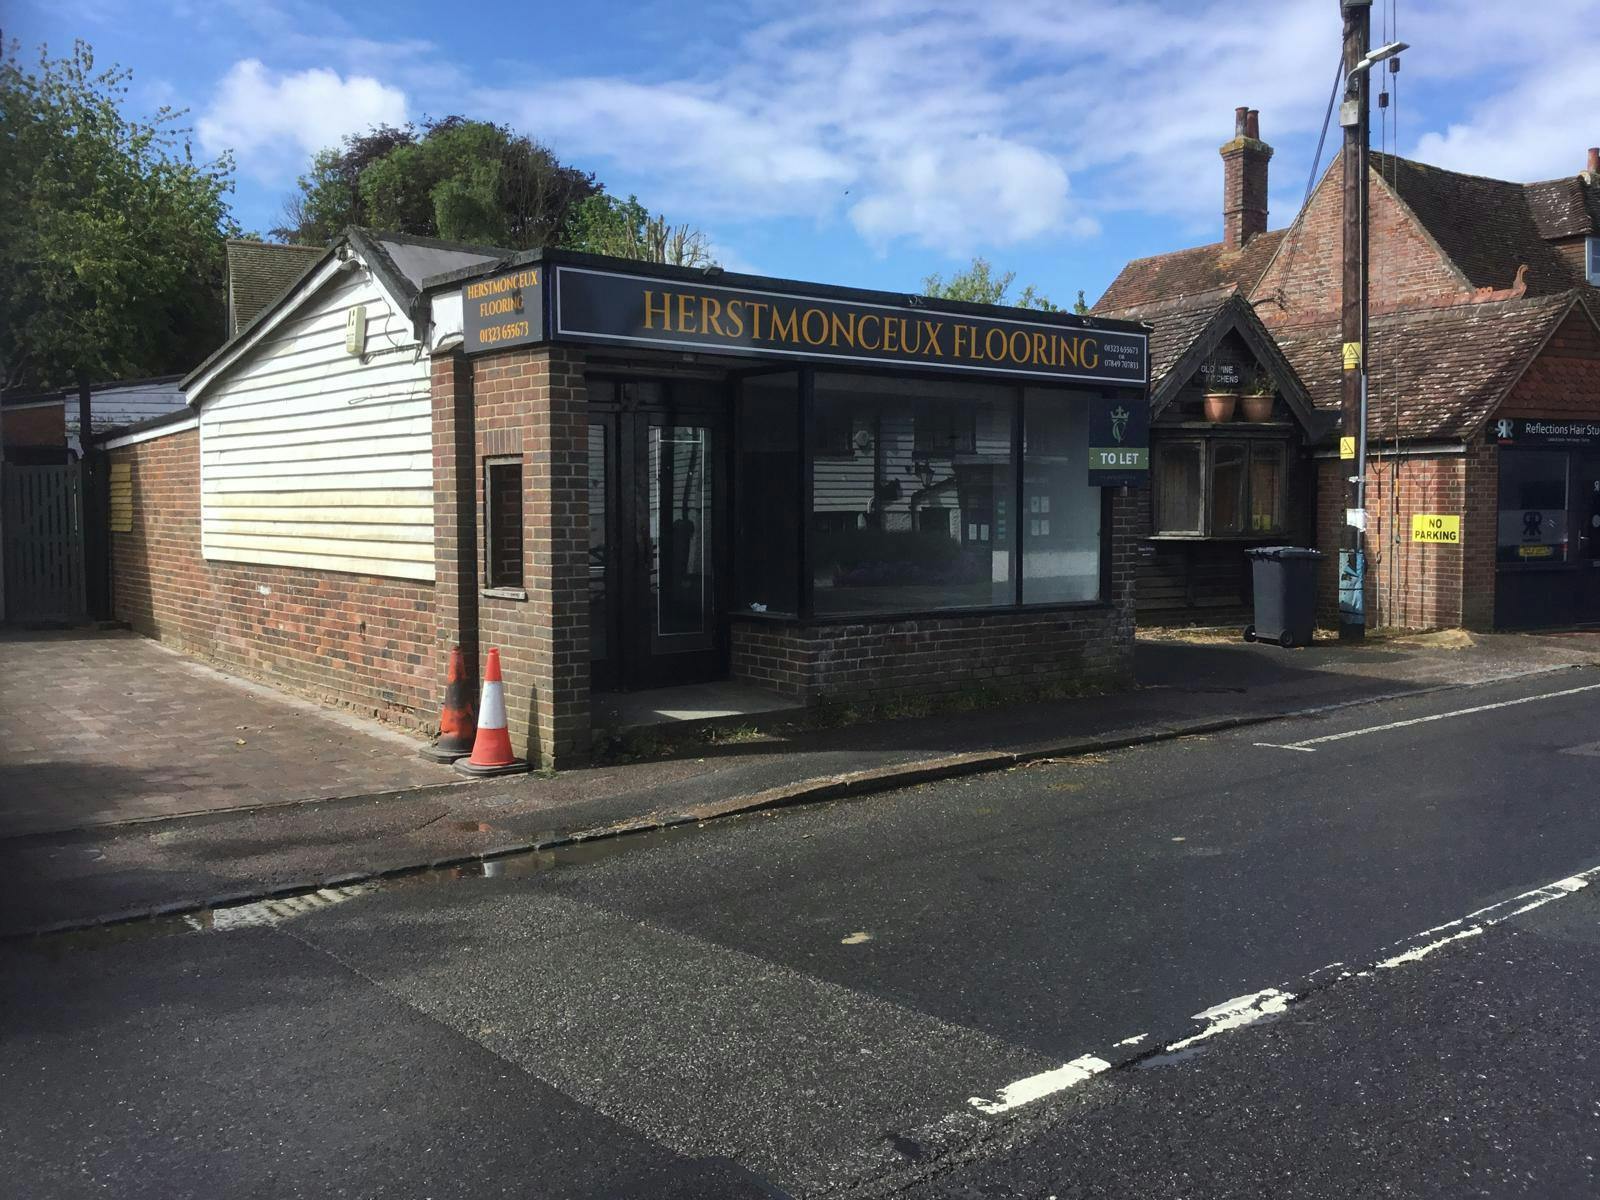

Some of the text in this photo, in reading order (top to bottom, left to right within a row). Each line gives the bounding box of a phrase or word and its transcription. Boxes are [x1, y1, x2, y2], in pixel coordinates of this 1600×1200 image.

[467, 271, 538, 300] HERSTMONCEUX
[480, 295, 524, 317] FLOORING
[480, 321, 528, 343] 01323 655673
[643, 290, 1099, 369] HERSTMONCEUX FLOORING
[1525, 423, 1568, 434] Reflections
[1569, 425, 1585, 435] Hair
[1100, 453, 1139, 465] TO LET
[1429, 518, 1442, 529] NO
[1415, 531, 1456, 541] PARKING
